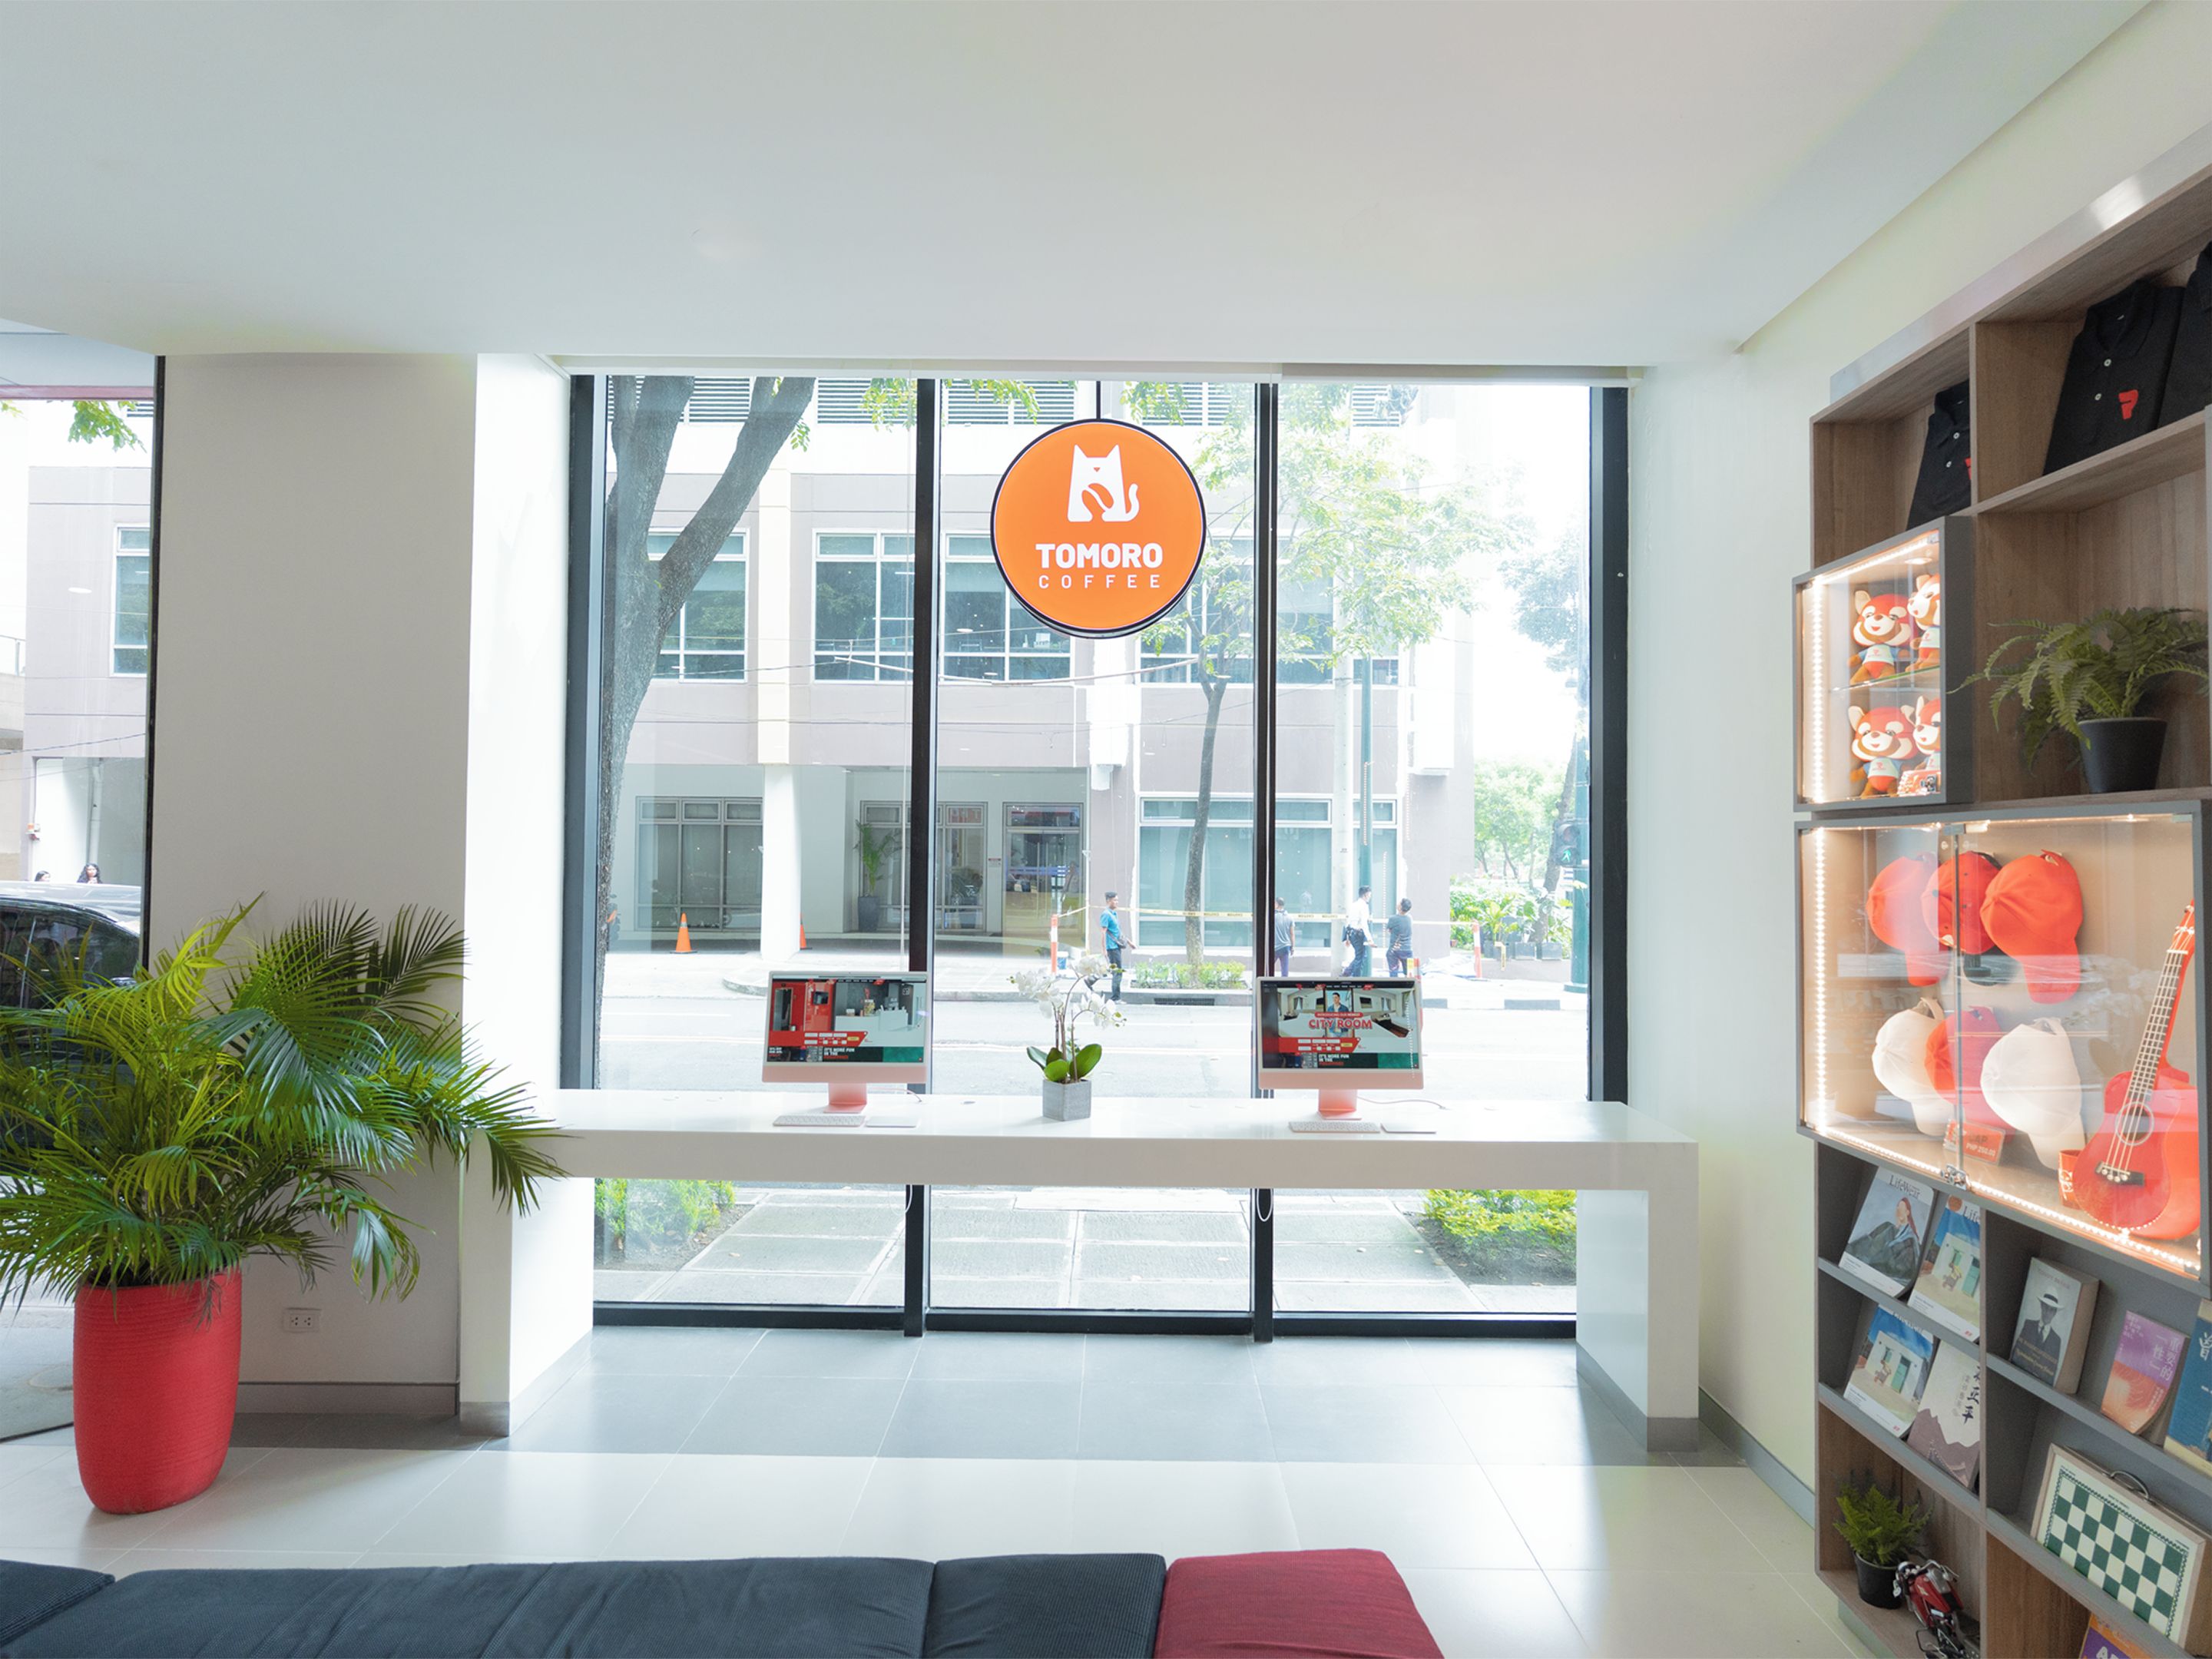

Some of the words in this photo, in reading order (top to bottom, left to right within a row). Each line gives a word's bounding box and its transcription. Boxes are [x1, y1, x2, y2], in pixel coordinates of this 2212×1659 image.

[1035, 543, 1164, 569] TOMORO
[1038, 574, 1161, 589] COFFEE
[1308, 1019, 1334, 1029] CITY
[1337, 1019, 1373, 1029] ROOM
[1889, 1174, 1920, 1200] LifeWear
